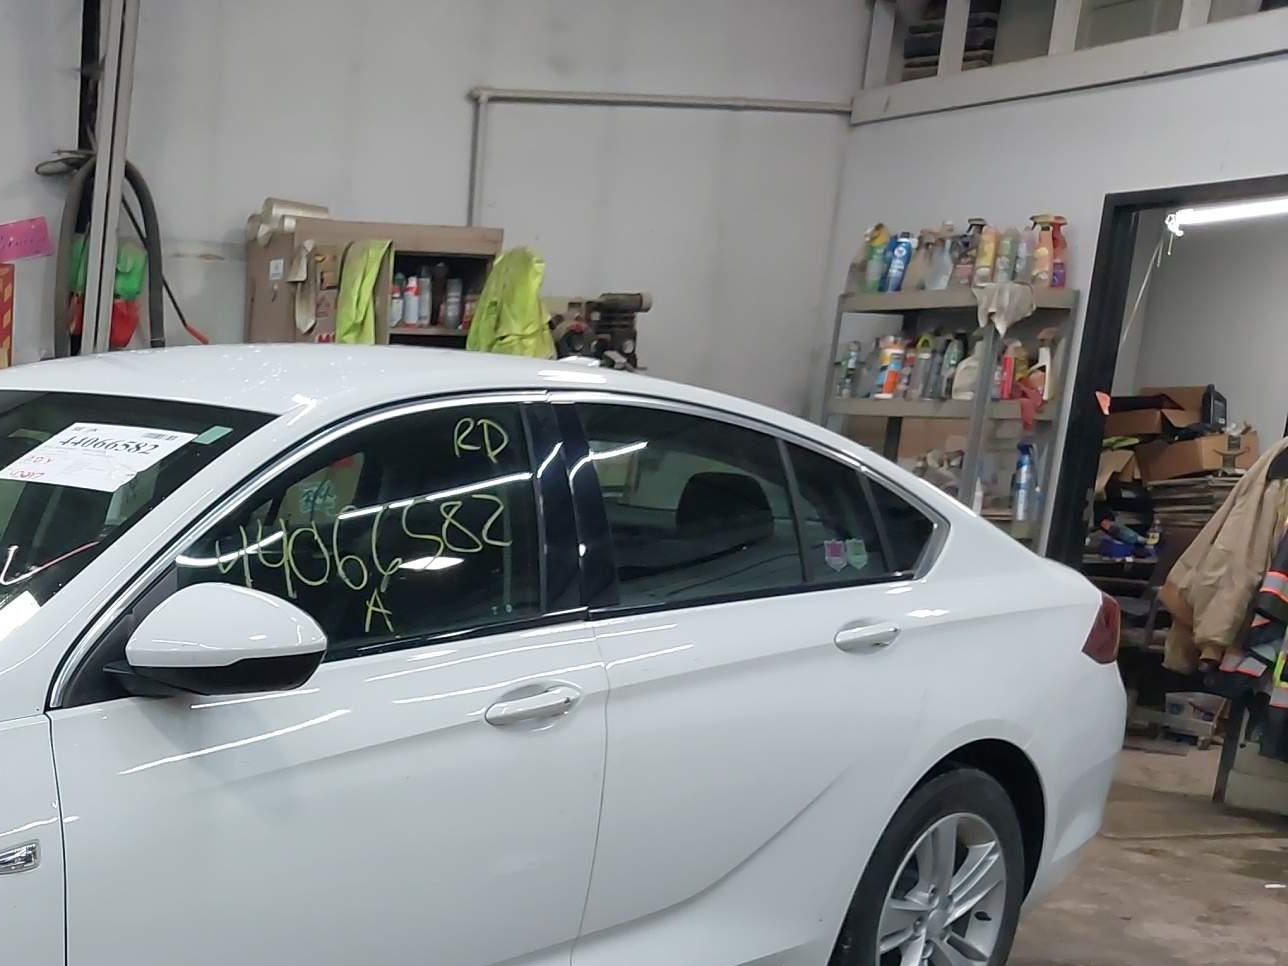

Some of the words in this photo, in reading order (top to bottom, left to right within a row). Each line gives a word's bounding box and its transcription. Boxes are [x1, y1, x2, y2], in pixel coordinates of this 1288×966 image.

[59, 434, 160, 456] 44066582
[453, 417, 509, 464] RD
[215, 493, 513, 599] 44066582
[364, 587, 395, 633] A
